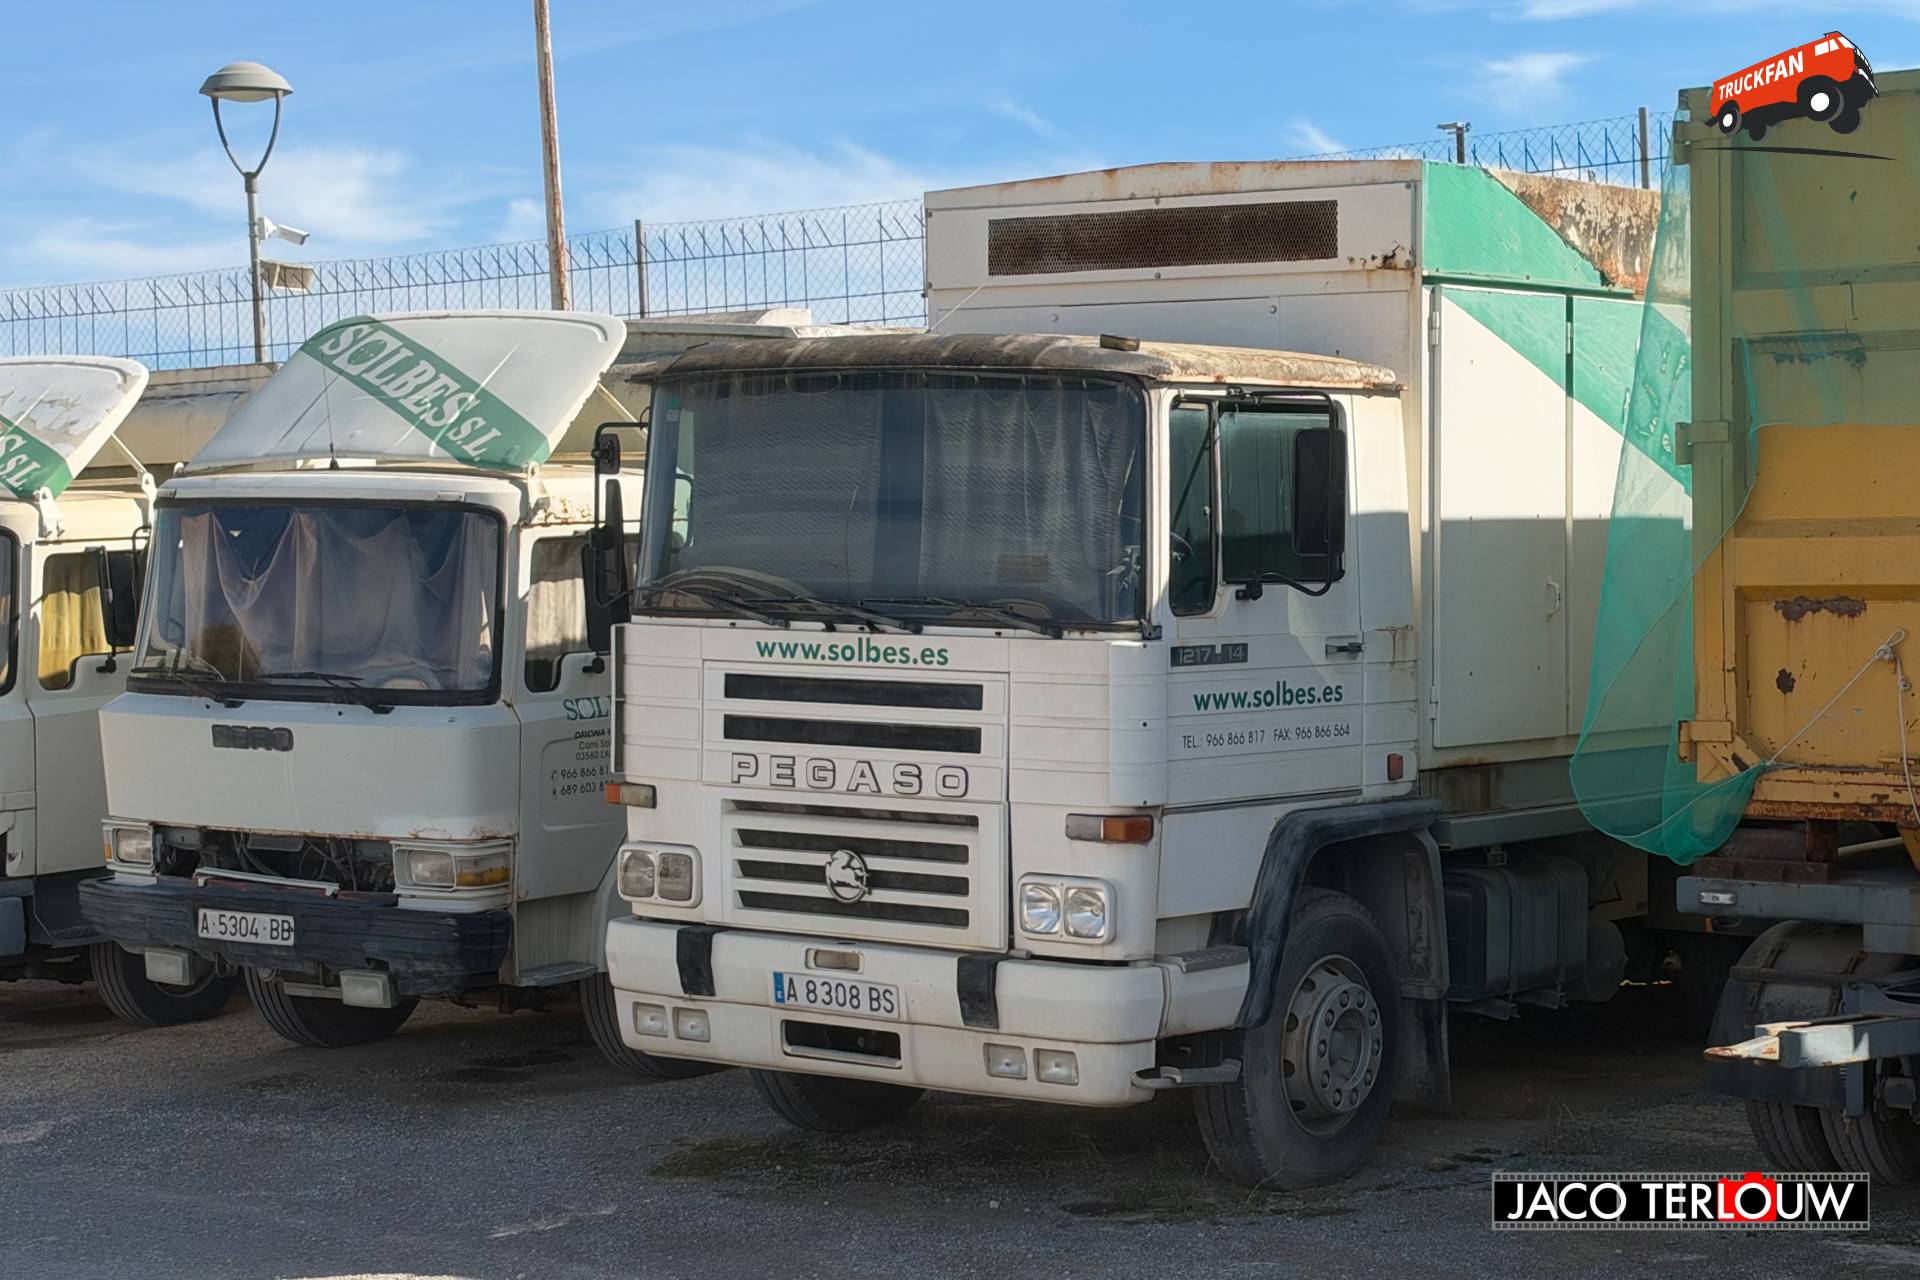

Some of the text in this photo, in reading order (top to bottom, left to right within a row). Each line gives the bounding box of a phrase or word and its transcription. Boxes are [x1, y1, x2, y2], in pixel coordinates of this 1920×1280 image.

[319, 324, 480, 427] SOLBES
[756, 637, 949, 666] www.solbes.es
[563, 695, 611, 721] SOL
[1193, 680, 1343, 711] www.solbes.es
[1206, 733, 1225, 747] 966
[1227, 732, 1245, 745] 866
[1248, 729, 1265, 744] 817
[1273, 728, 1292, 741] FAX:
[1295, 727, 1312, 740] 966
[1314, 725, 1332, 739] 866
[1333, 724, 1350, 737] 564
[560, 765, 609, 779] 966 866 81
[731, 752, 969, 798] PEGASO
[560, 784, 578, 796] 689
[580, 782, 597, 793] 603
[787, 976, 895, 1014] A 8308 BS
